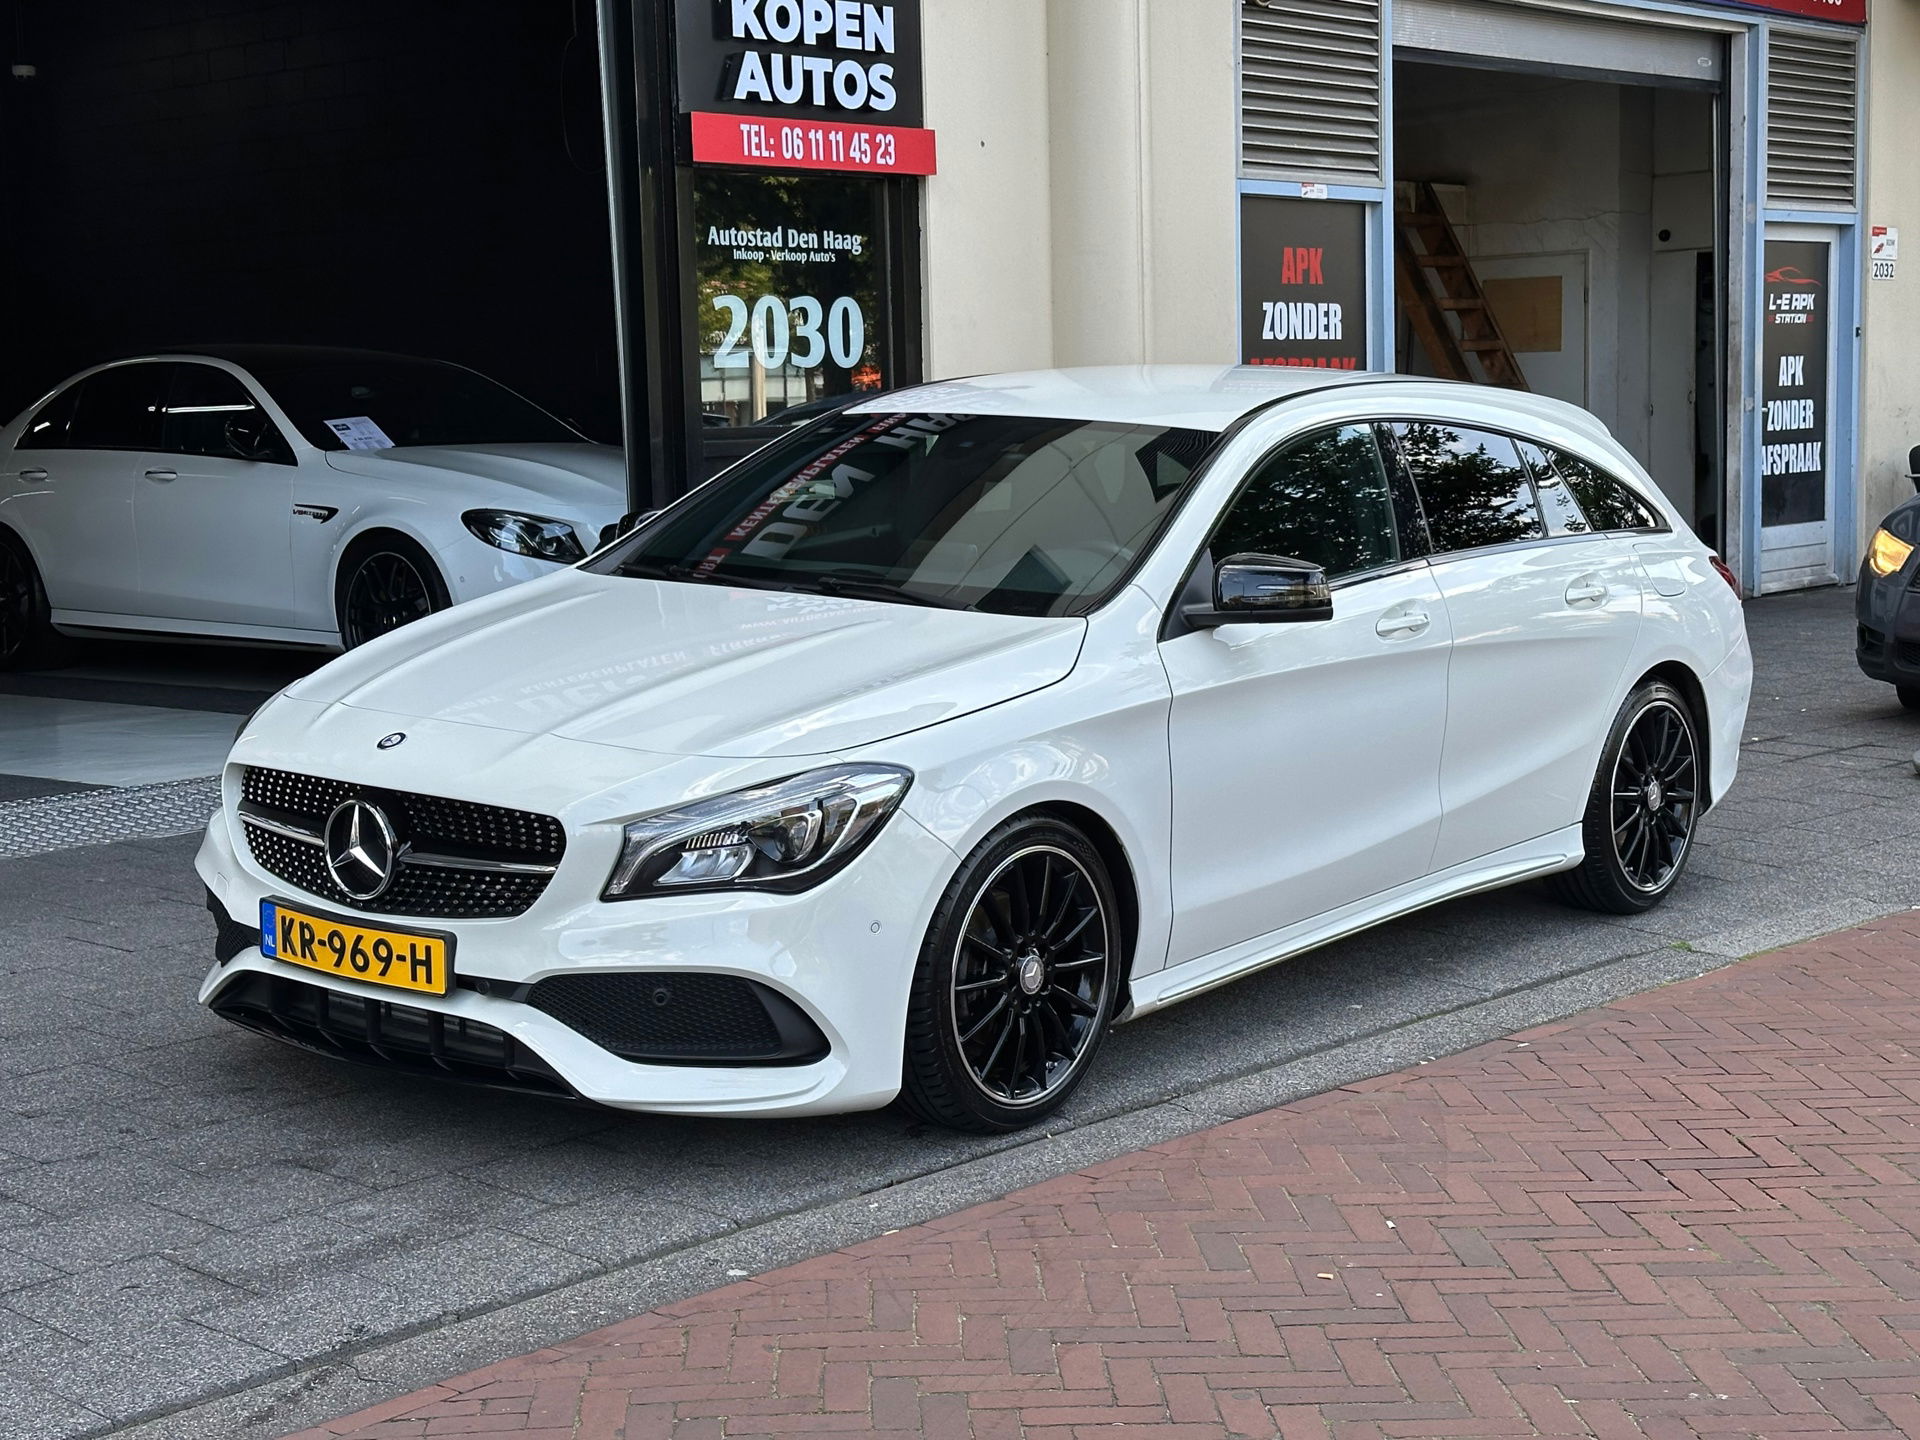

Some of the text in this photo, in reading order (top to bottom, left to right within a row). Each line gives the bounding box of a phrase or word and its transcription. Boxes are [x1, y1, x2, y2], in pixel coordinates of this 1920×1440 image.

[731, 0, 895, 54] KOPEN
[733, 50, 897, 111] AUTOS
[740, 123, 895, 166] TEL: 06 11 11 45 23
[707, 225, 862, 255] Autostad Den Haag
[733, 249, 764, 263] Inkoop
[770, 250, 807, 264] Verkoop
[809, 251, 836, 263] Auto's
[1281, 246, 1324, 285] APK
[1873, 263, 1895, 279] 2032
[1768, 293, 1815, 310] L-E APK
[712, 294, 864, 369] 2030
[1262, 301, 1342, 340] ZONDER
[1775, 313, 1807, 324] STATION
[1778, 355, 1804, 387] APK
[1766, 399, 1814, 432] ZONDER
[1761, 442, 1821, 476] AFSPRAAK
[264, 933, 275, 948] NL
[280, 914, 433, 985] KR-969-H
